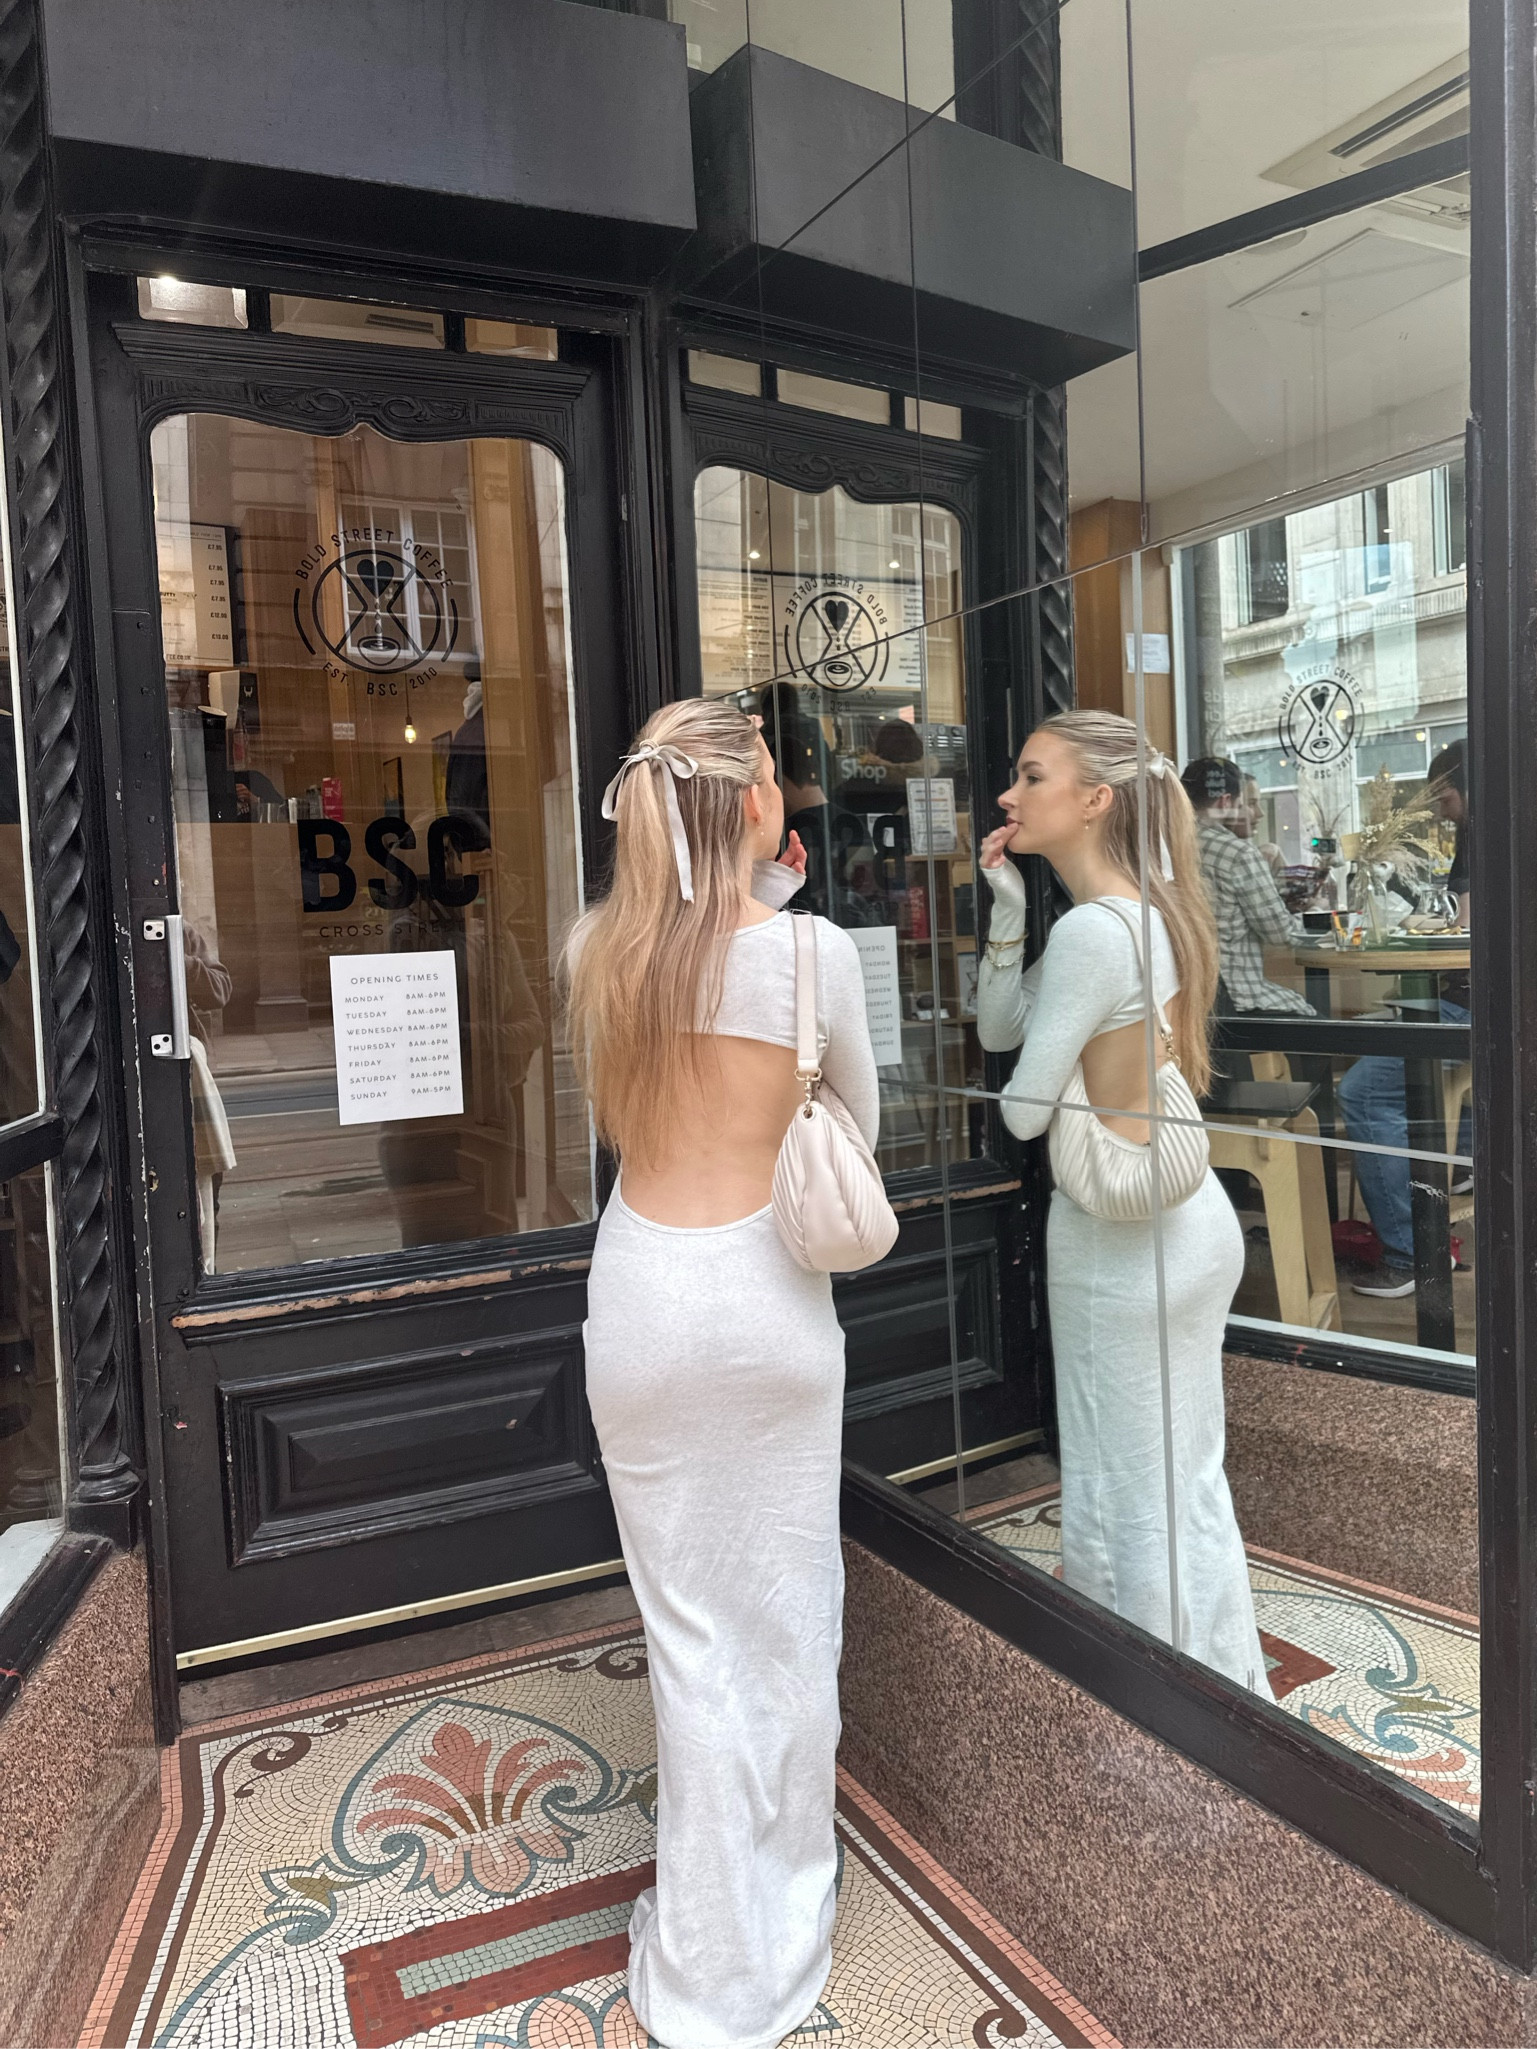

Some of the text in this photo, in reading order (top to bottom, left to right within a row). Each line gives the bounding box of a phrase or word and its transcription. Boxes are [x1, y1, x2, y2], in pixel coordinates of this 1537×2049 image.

[295, 527, 454, 589] BOLD STREET COFFEE
[367, 682, 398, 696] BSC
[410, 666, 438, 689] 2010
[1296, 664, 1330, 684] STREET
[1334, 667, 1364, 697] COFFEE
[841, 757, 887, 785] Shop
[297, 816, 479, 913] BSC
[319, 924, 384, 938] CROSS
[350, 973, 440, 985] OPENING TIMES
[345, 991, 446, 1004] MONDAY 8AM-6PM
[346, 1006, 447, 1020] TUESDAY 8AM-6PM
[347, 1022, 448, 1036] WEDNESDAY 8AM-6PM
[348, 1038, 449, 1052] THURSDAY 8AM-6PM
[349, 1054, 450, 1068] FRIDAY 8AM-6PM
[350, 1069, 451, 1084] SATURDAY 8AM-6PM
[350, 1085, 451, 1100] SUNDAY 9AM-5PM
